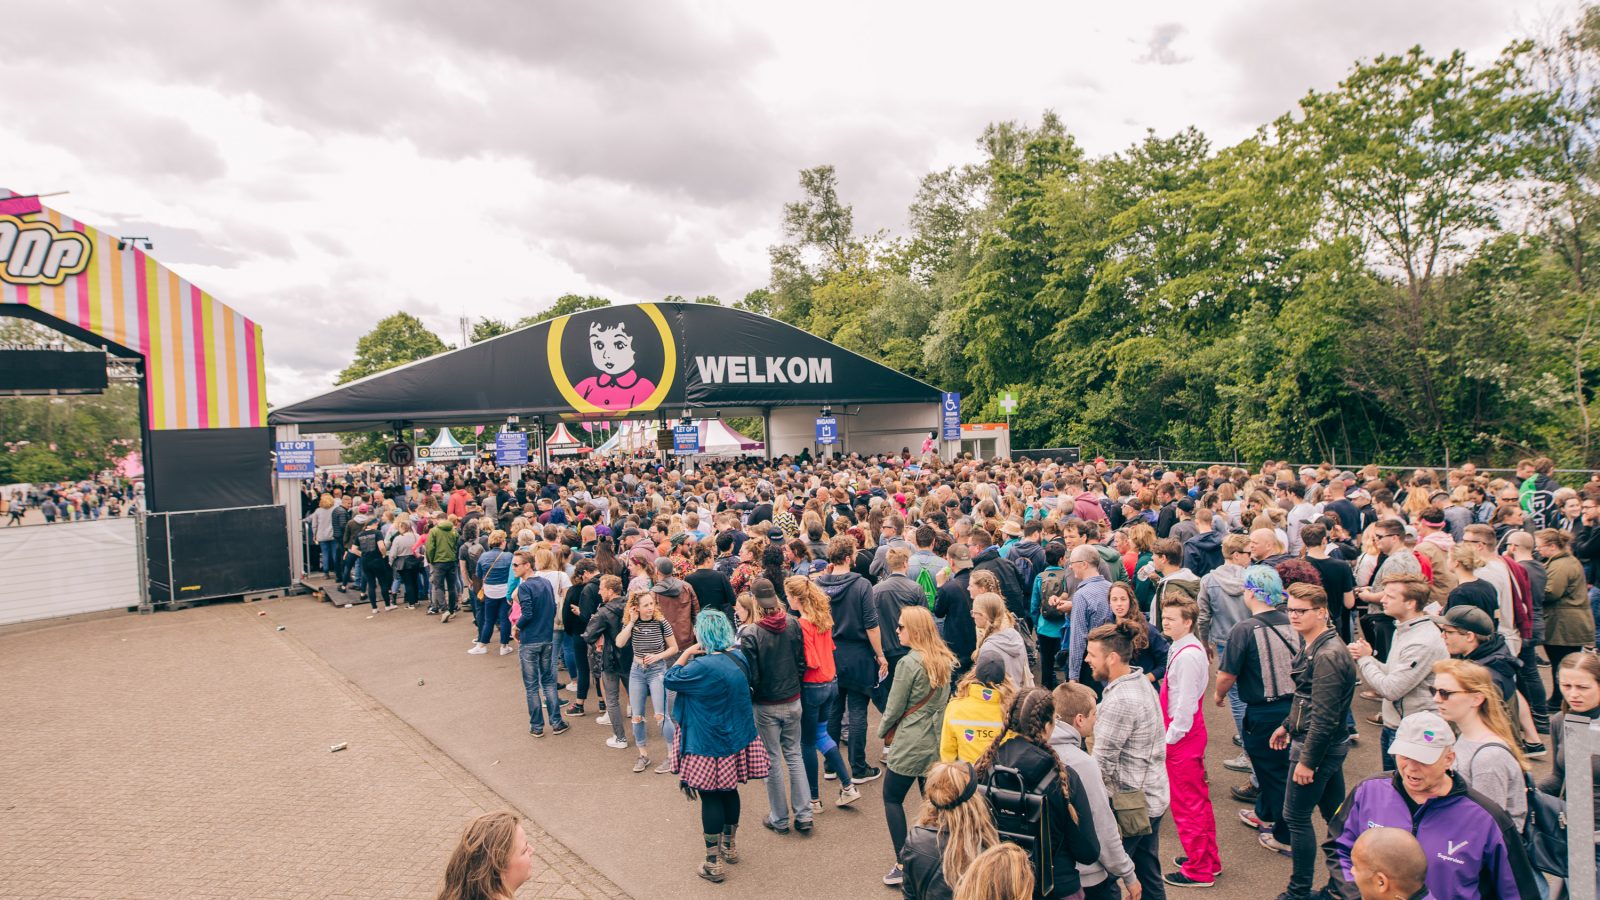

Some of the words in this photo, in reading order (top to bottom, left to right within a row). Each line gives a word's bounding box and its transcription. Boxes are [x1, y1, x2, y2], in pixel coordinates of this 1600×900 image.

[695, 355, 833, 384] WELKOM
[280, 442, 294, 450] LET
[295, 442, 306, 450] OP
[976, 729, 994, 739] TSC
